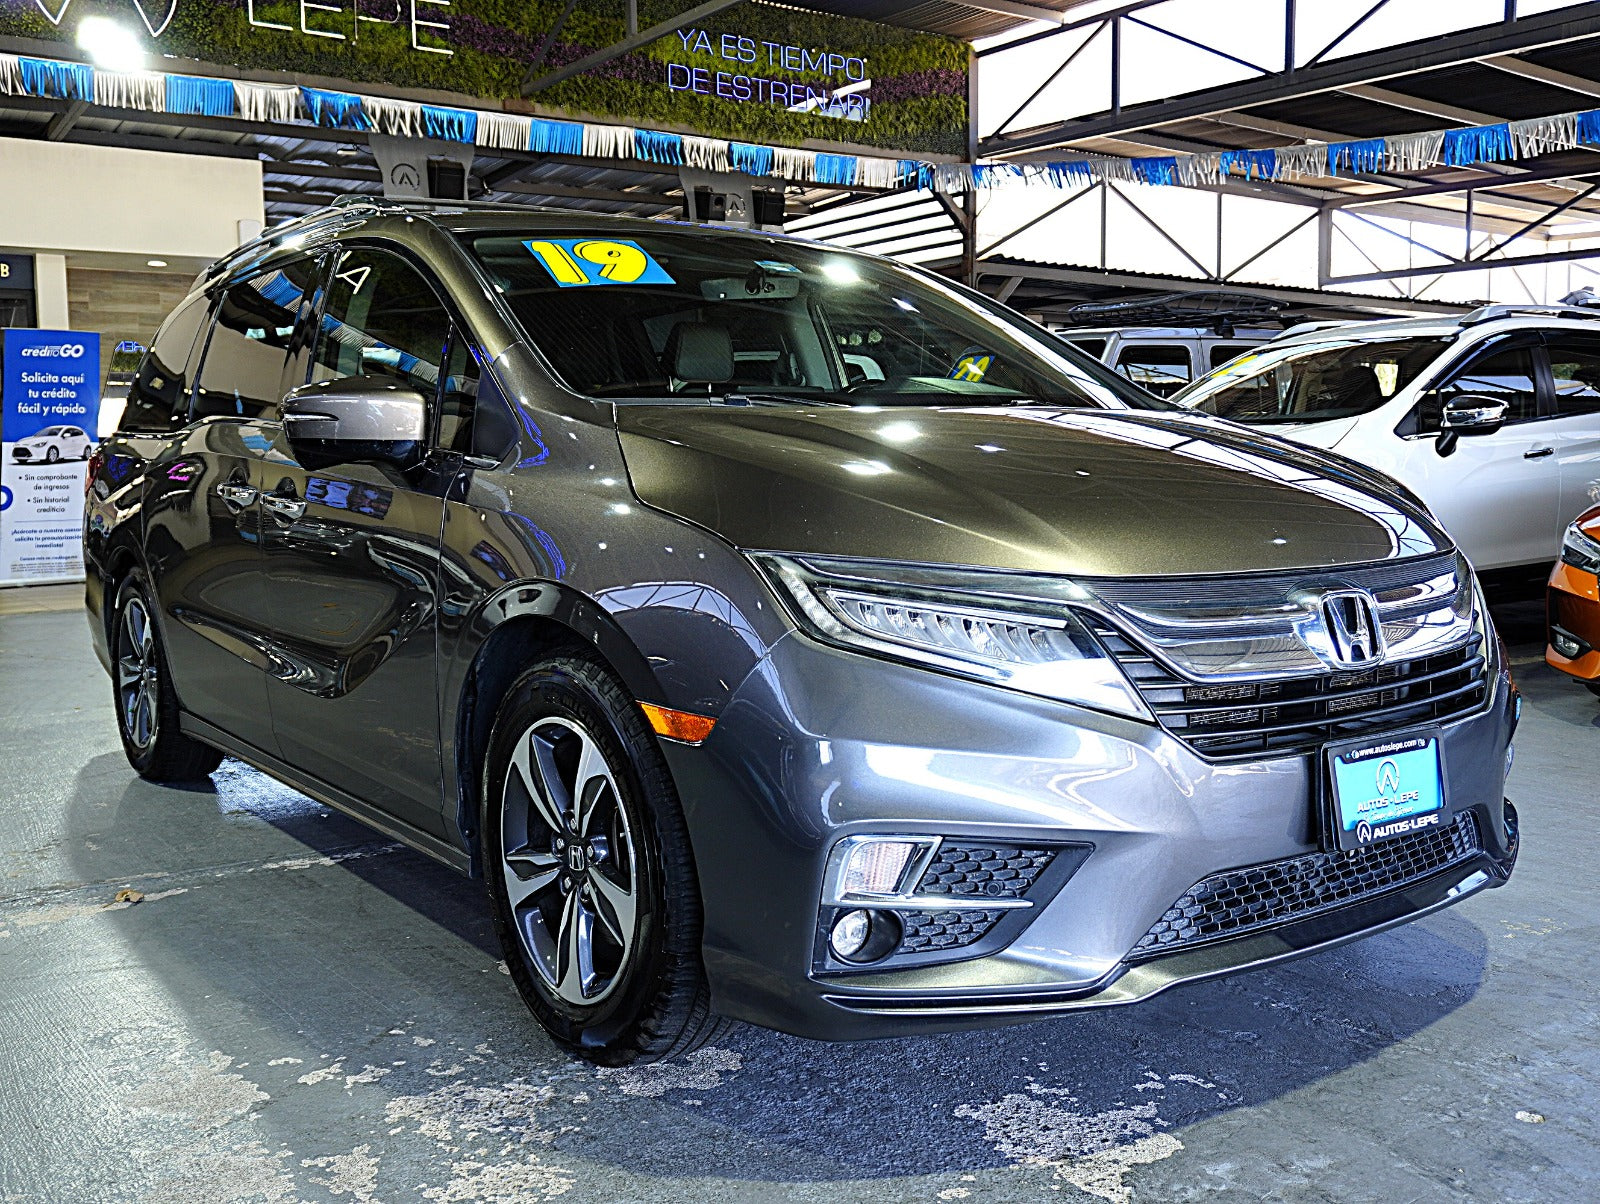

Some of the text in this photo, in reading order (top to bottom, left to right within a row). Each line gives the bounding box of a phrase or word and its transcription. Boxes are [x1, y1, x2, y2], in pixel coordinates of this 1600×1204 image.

[677, 28, 864, 81] YA ES TIEMPO
[668, 63, 871, 121] DE ESTRENAR!
[531, 240, 648, 285] 19
[21, 372, 85, 386] Solicita aquí
[28, 388, 77, 399] tu crédito
[17, 402, 86, 416] fácil y rápido
[36, 474, 78, 483] comprobante
[43, 484, 69, 492] ingresos
[1359, 739, 1417, 756] www.autoslepe.com
